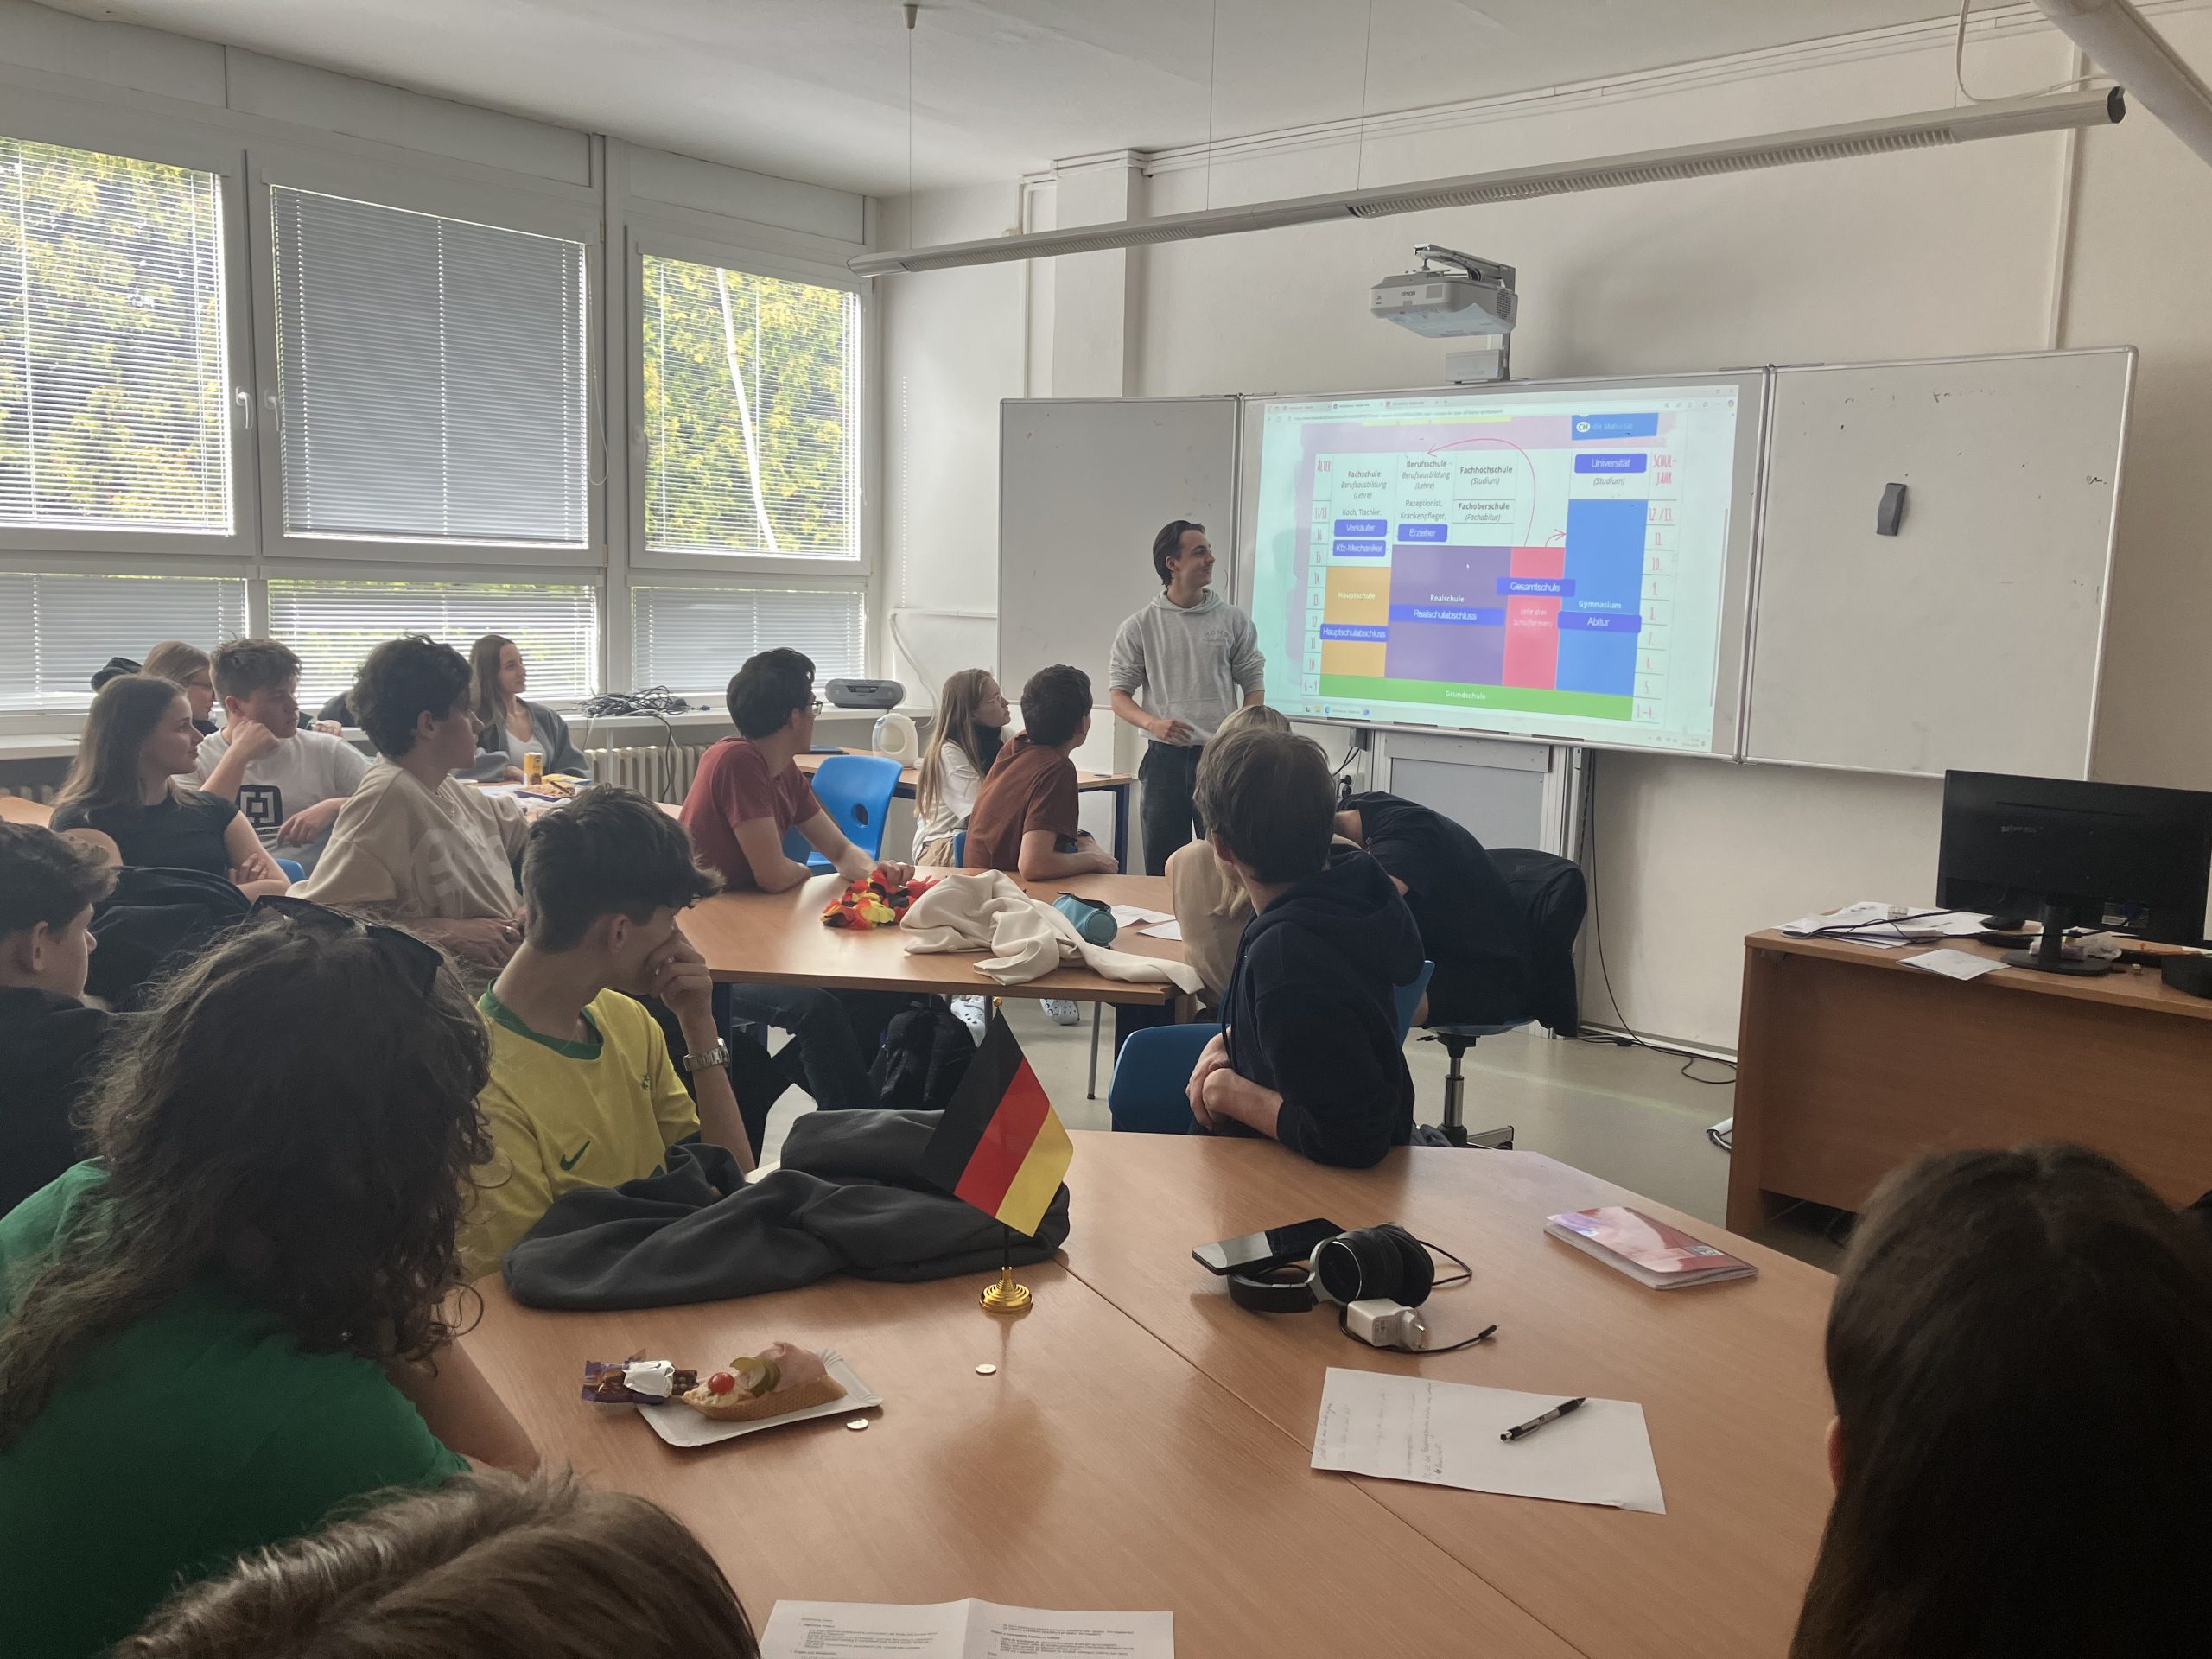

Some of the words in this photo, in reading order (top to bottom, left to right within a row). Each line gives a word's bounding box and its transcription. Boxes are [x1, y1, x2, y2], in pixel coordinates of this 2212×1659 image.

[1406, 460, 1447, 468] Berufsschule
[1591, 458, 1630, 468] Universität
[1459, 466, 1513, 474] Fachhochschule
[1402, 471, 1450, 480] Berufsausbildung
[1340, 480, 1387, 490] Berufsausbildung
[1471, 477, 1500, 486] (Studium)
[1593, 477, 1625, 486] (Studium)
[1414, 482, 1435, 491] (Lehre)
[1353, 492, 1372, 500] (Lehre)
[1458, 502, 1510, 511] Fachoberschule
[1342, 508, 1358, 518] Koch,
[1400, 512, 1447, 522] Krankenpfleger,
[1465, 513, 1501, 523] (Fachabitur)
[1346, 524, 1376, 532] Verkäufer
[1408, 528, 1437, 537] Erzieher
[1335, 543, 1383, 553] Kfz-Mechaniker
[1510, 581, 1561, 593] Gesamtschule
[1338, 592, 1376, 601] Hauptschule
[1430, 594, 1465, 603] Realschule
[1578, 600, 1622, 610] Gymnasium
[1413, 608, 1478, 621] Realschulabschluss
[1586, 616, 1611, 627] Abitur
[1323, 627, 1387, 639] Hauptschulabschluss
[1445, 690, 1487, 701] Grundschule
